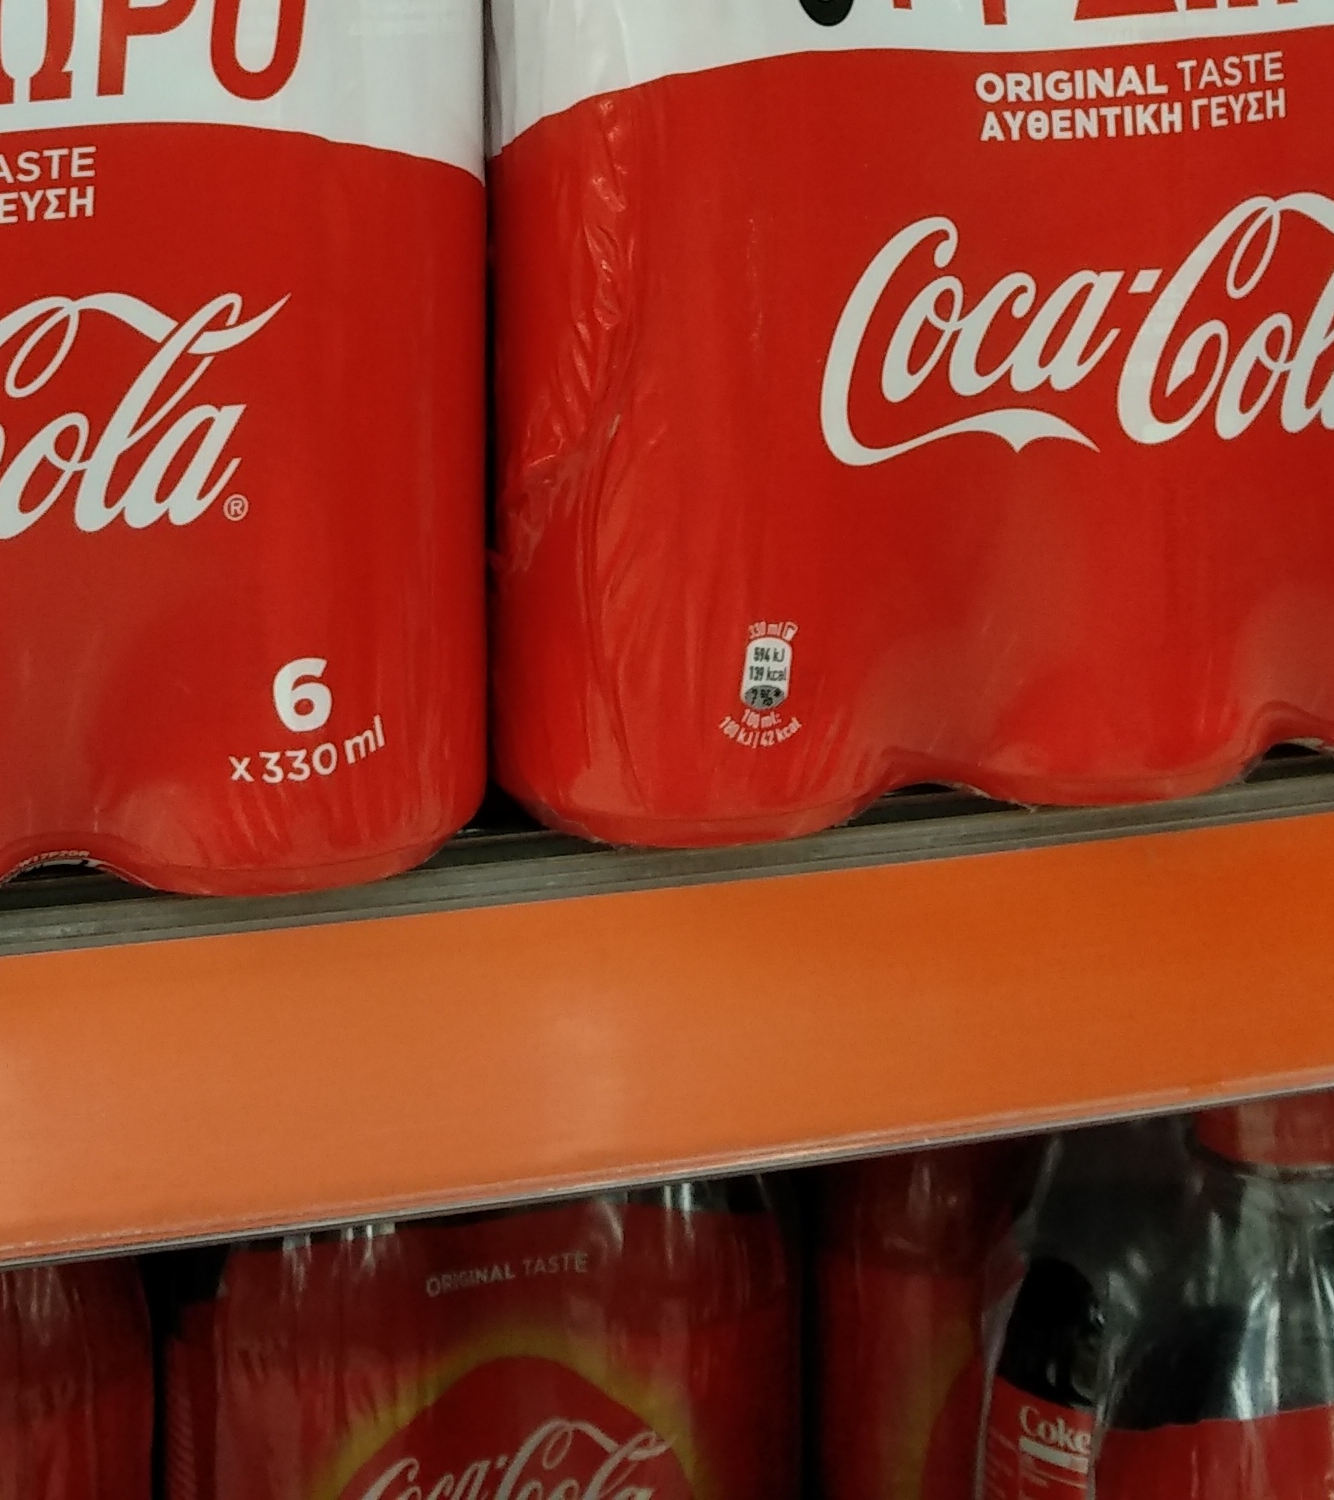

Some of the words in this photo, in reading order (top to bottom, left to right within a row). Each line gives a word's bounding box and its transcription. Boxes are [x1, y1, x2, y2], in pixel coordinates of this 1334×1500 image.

[975, 64, 1167, 104] ORIGINAL
[1177, 52, 1284, 93] TASTE
[980, 105, 1183, 141] ΑΥΘΕΝΤΙΚΗ
[1191, 89, 1285, 131] ΓΕΥΣΗ
[273, 657, 332, 732] 6
